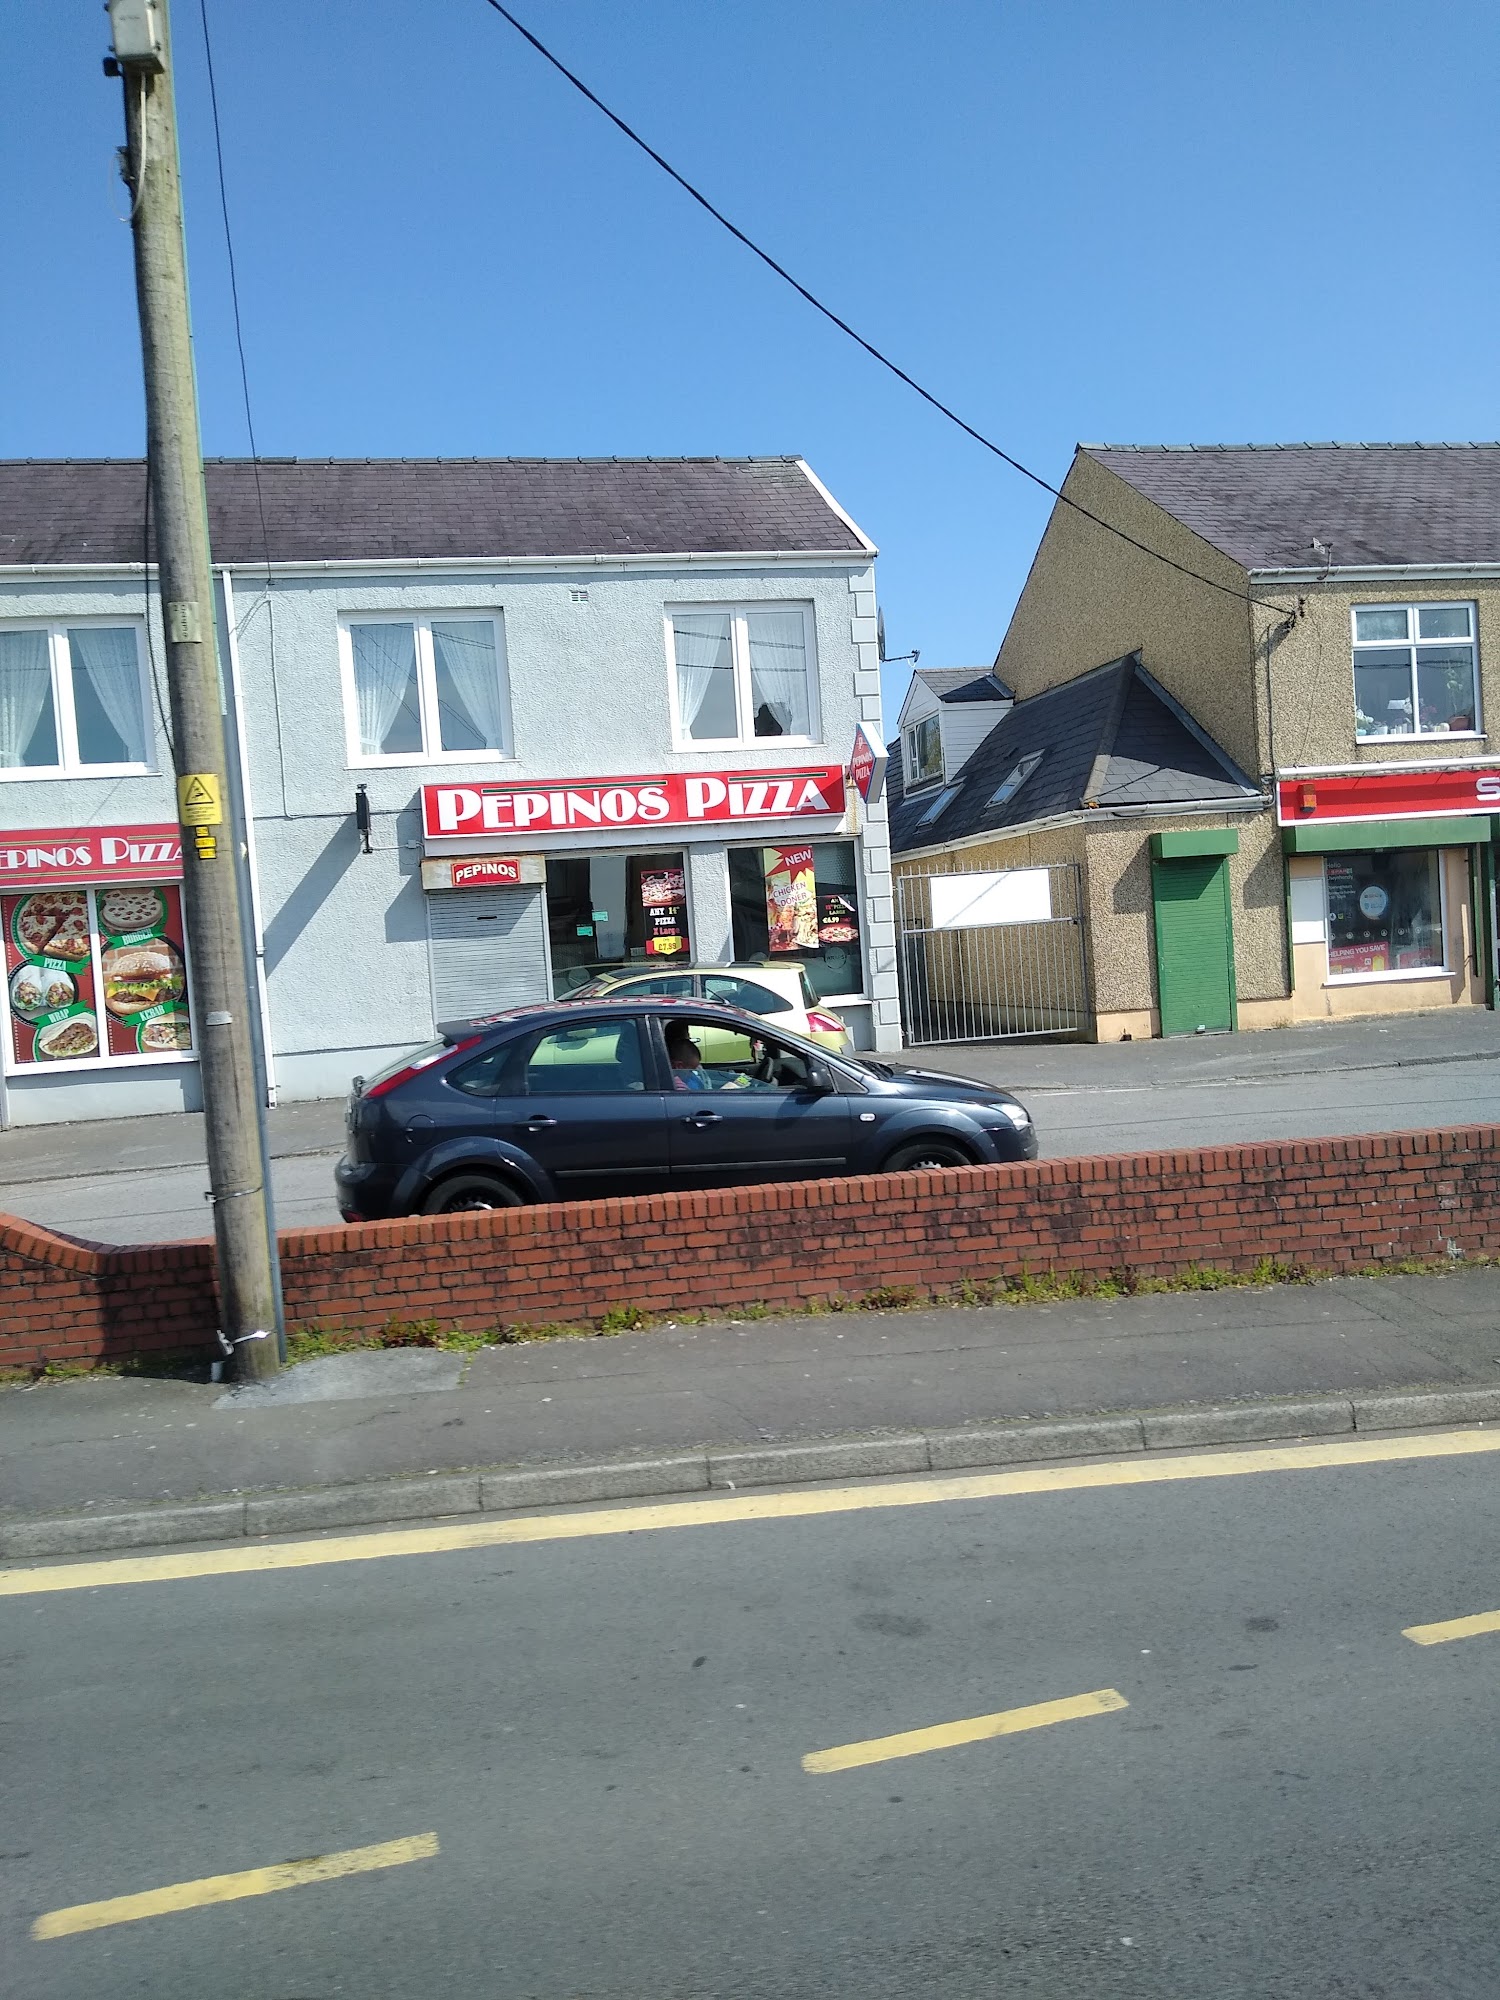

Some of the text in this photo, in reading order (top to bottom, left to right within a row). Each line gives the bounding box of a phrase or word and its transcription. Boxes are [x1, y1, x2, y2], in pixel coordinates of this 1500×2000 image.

[437, 777, 831, 831] PEPINOS PIZZA
[784, 849, 811, 867] NEW
[772, 882, 806, 898] CHICKEN
[780, 892, 807, 907] DONER
[649, 907, 665, 916] ANY
[654, 916, 676, 926] PIZZA
[1329, 949, 1355, 958] HELPING
[1355, 946, 1370, 955] YOU
[1369, 943, 1386, 952] SAVE
[43, 957, 67, 971] PIZZA
[47, 1008, 70, 1024] WRAP
[138, 1004, 166, 1023] KEBAB
